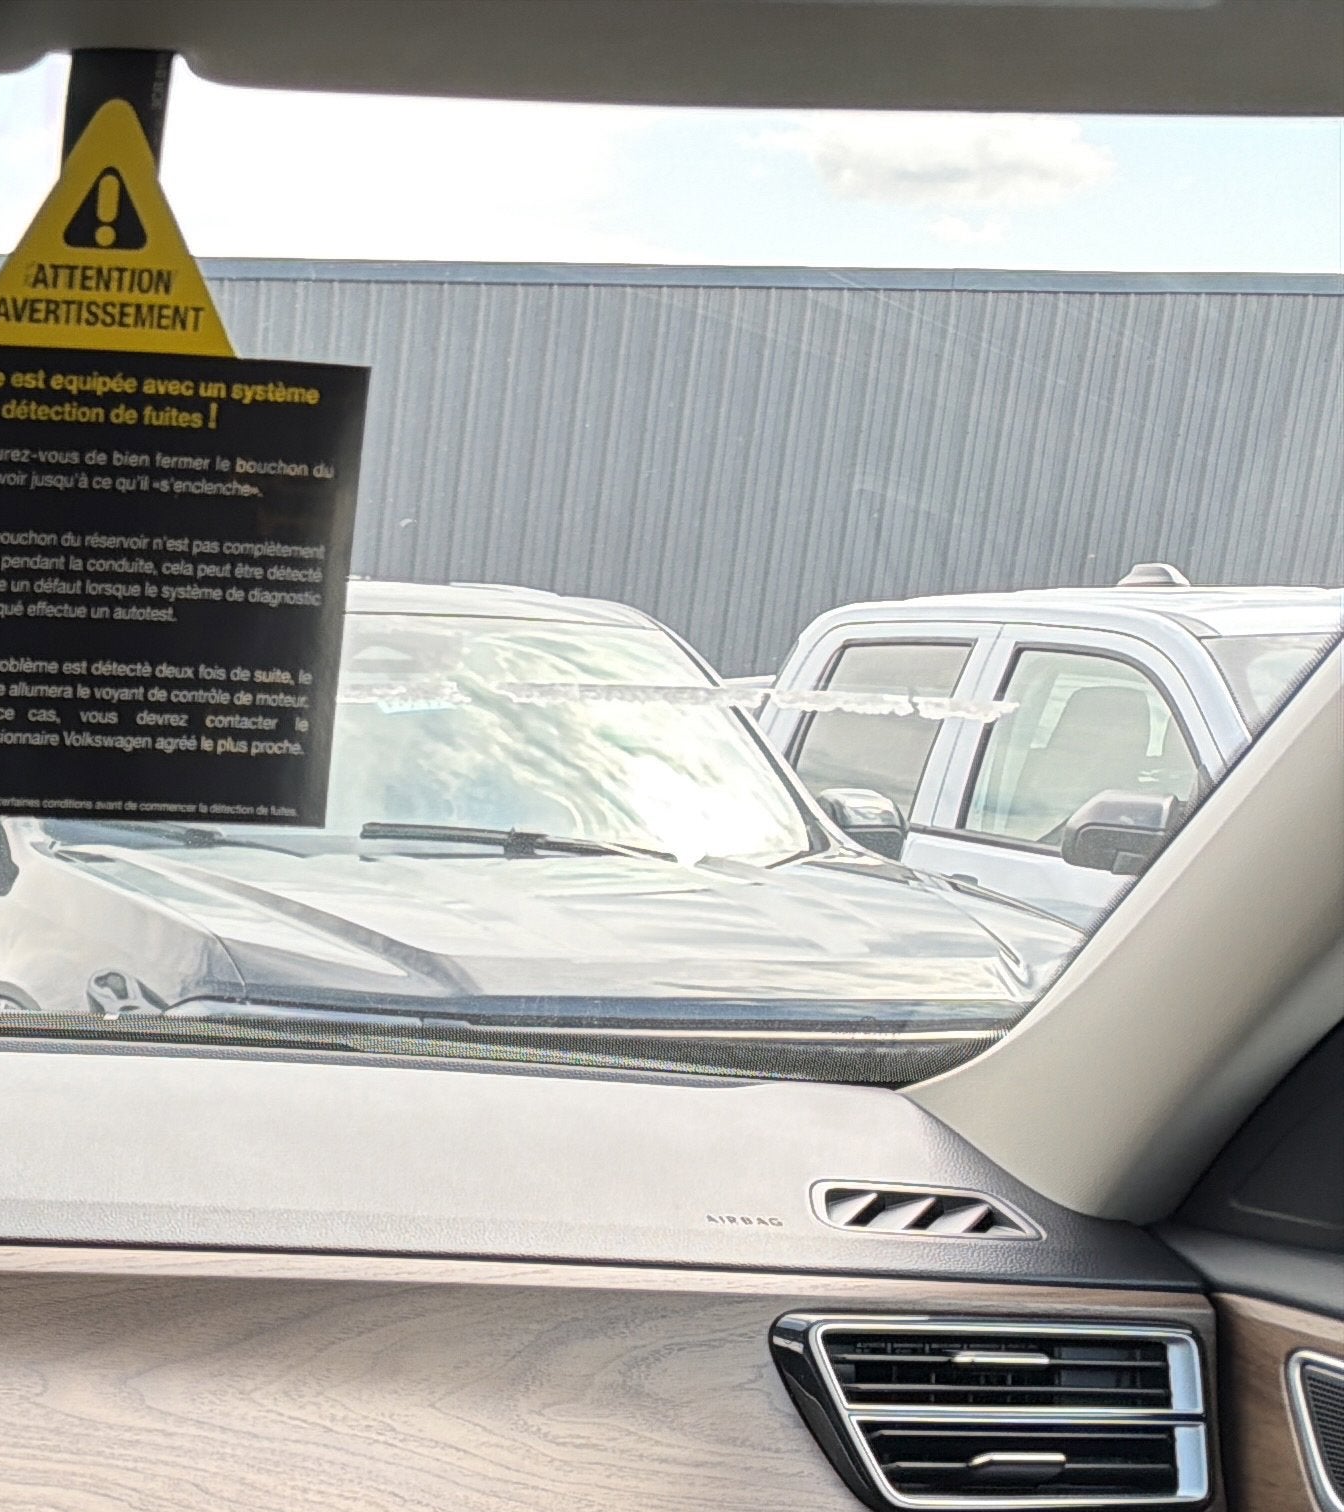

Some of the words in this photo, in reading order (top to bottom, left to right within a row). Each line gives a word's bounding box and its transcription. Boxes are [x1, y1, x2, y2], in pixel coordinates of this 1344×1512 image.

[31, 263, 172, 294] ATTENTION
[11, 369, 45, 388] est
[143, 379, 194, 396] avec
[199, 382, 226, 398] un
[231, 380, 320, 404] système
[1, 401, 104, 423] détection
[110, 405, 138, 424] de
[143, 406, 203, 428] fuites
[85, 450, 107, 465] de
[113, 451, 150, 467] bien
[156, 453, 210, 470] fermer
[216, 455, 230, 471] le
[235, 458, 308, 476] bouchon
[313, 463, 334, 478] du
[92, 476, 112, 489] ce
[61, 531, 81, 547] du
[85, 533, 150, 550] réservoir
[153, 536, 189, 552] n'est
[192, 540, 220, 555] pas
[1, 554, 65, 573] pendant
[69, 555, 83, 571] la
[87, 557, 158, 575] conduite,
[162, 560, 193, 575] cela
[197, 563, 231, 578] peut
[235, 563, 264, 579] être
[267, 566, 321, 582] détecté
[11, 581, 30, 592] un
[34, 578, 82, 594] défaut
[86, 580, 141, 598] lorsque
[145, 582, 158, 597] le
[161, 584, 223, 603] système
[225, 586, 245, 602] de
[248, 589, 319, 609] diagnostic
[27, 601, 87, 618] effectue
[91, 606, 110, 619] un
[63, 661, 87, 674] est
[155, 662, 194, 678] deux
[199, 664, 226, 680] fois
[230, 666, 251, 682] de
[254, 668, 294, 686] suite,
[299, 670, 312, 684] le
[9, 683, 73, 698] allumera
[77, 684, 91, 698] le
[94, 686, 144, 704] voyant
[147, 686, 168, 702] de
[233, 690, 253, 705] de
[28, 709, 60, 726] cas,
[80, 711, 118, 724] vous
[136, 710, 188, 727] devrez
[205, 714, 278, 730] contacter
[295, 718, 308, 732] le
[63, 732, 152, 752] Volkswagen
[201, 736, 214, 752] le
[217, 737, 248, 755] plus
[705, 1213, 784, 1228] AIRBAG
